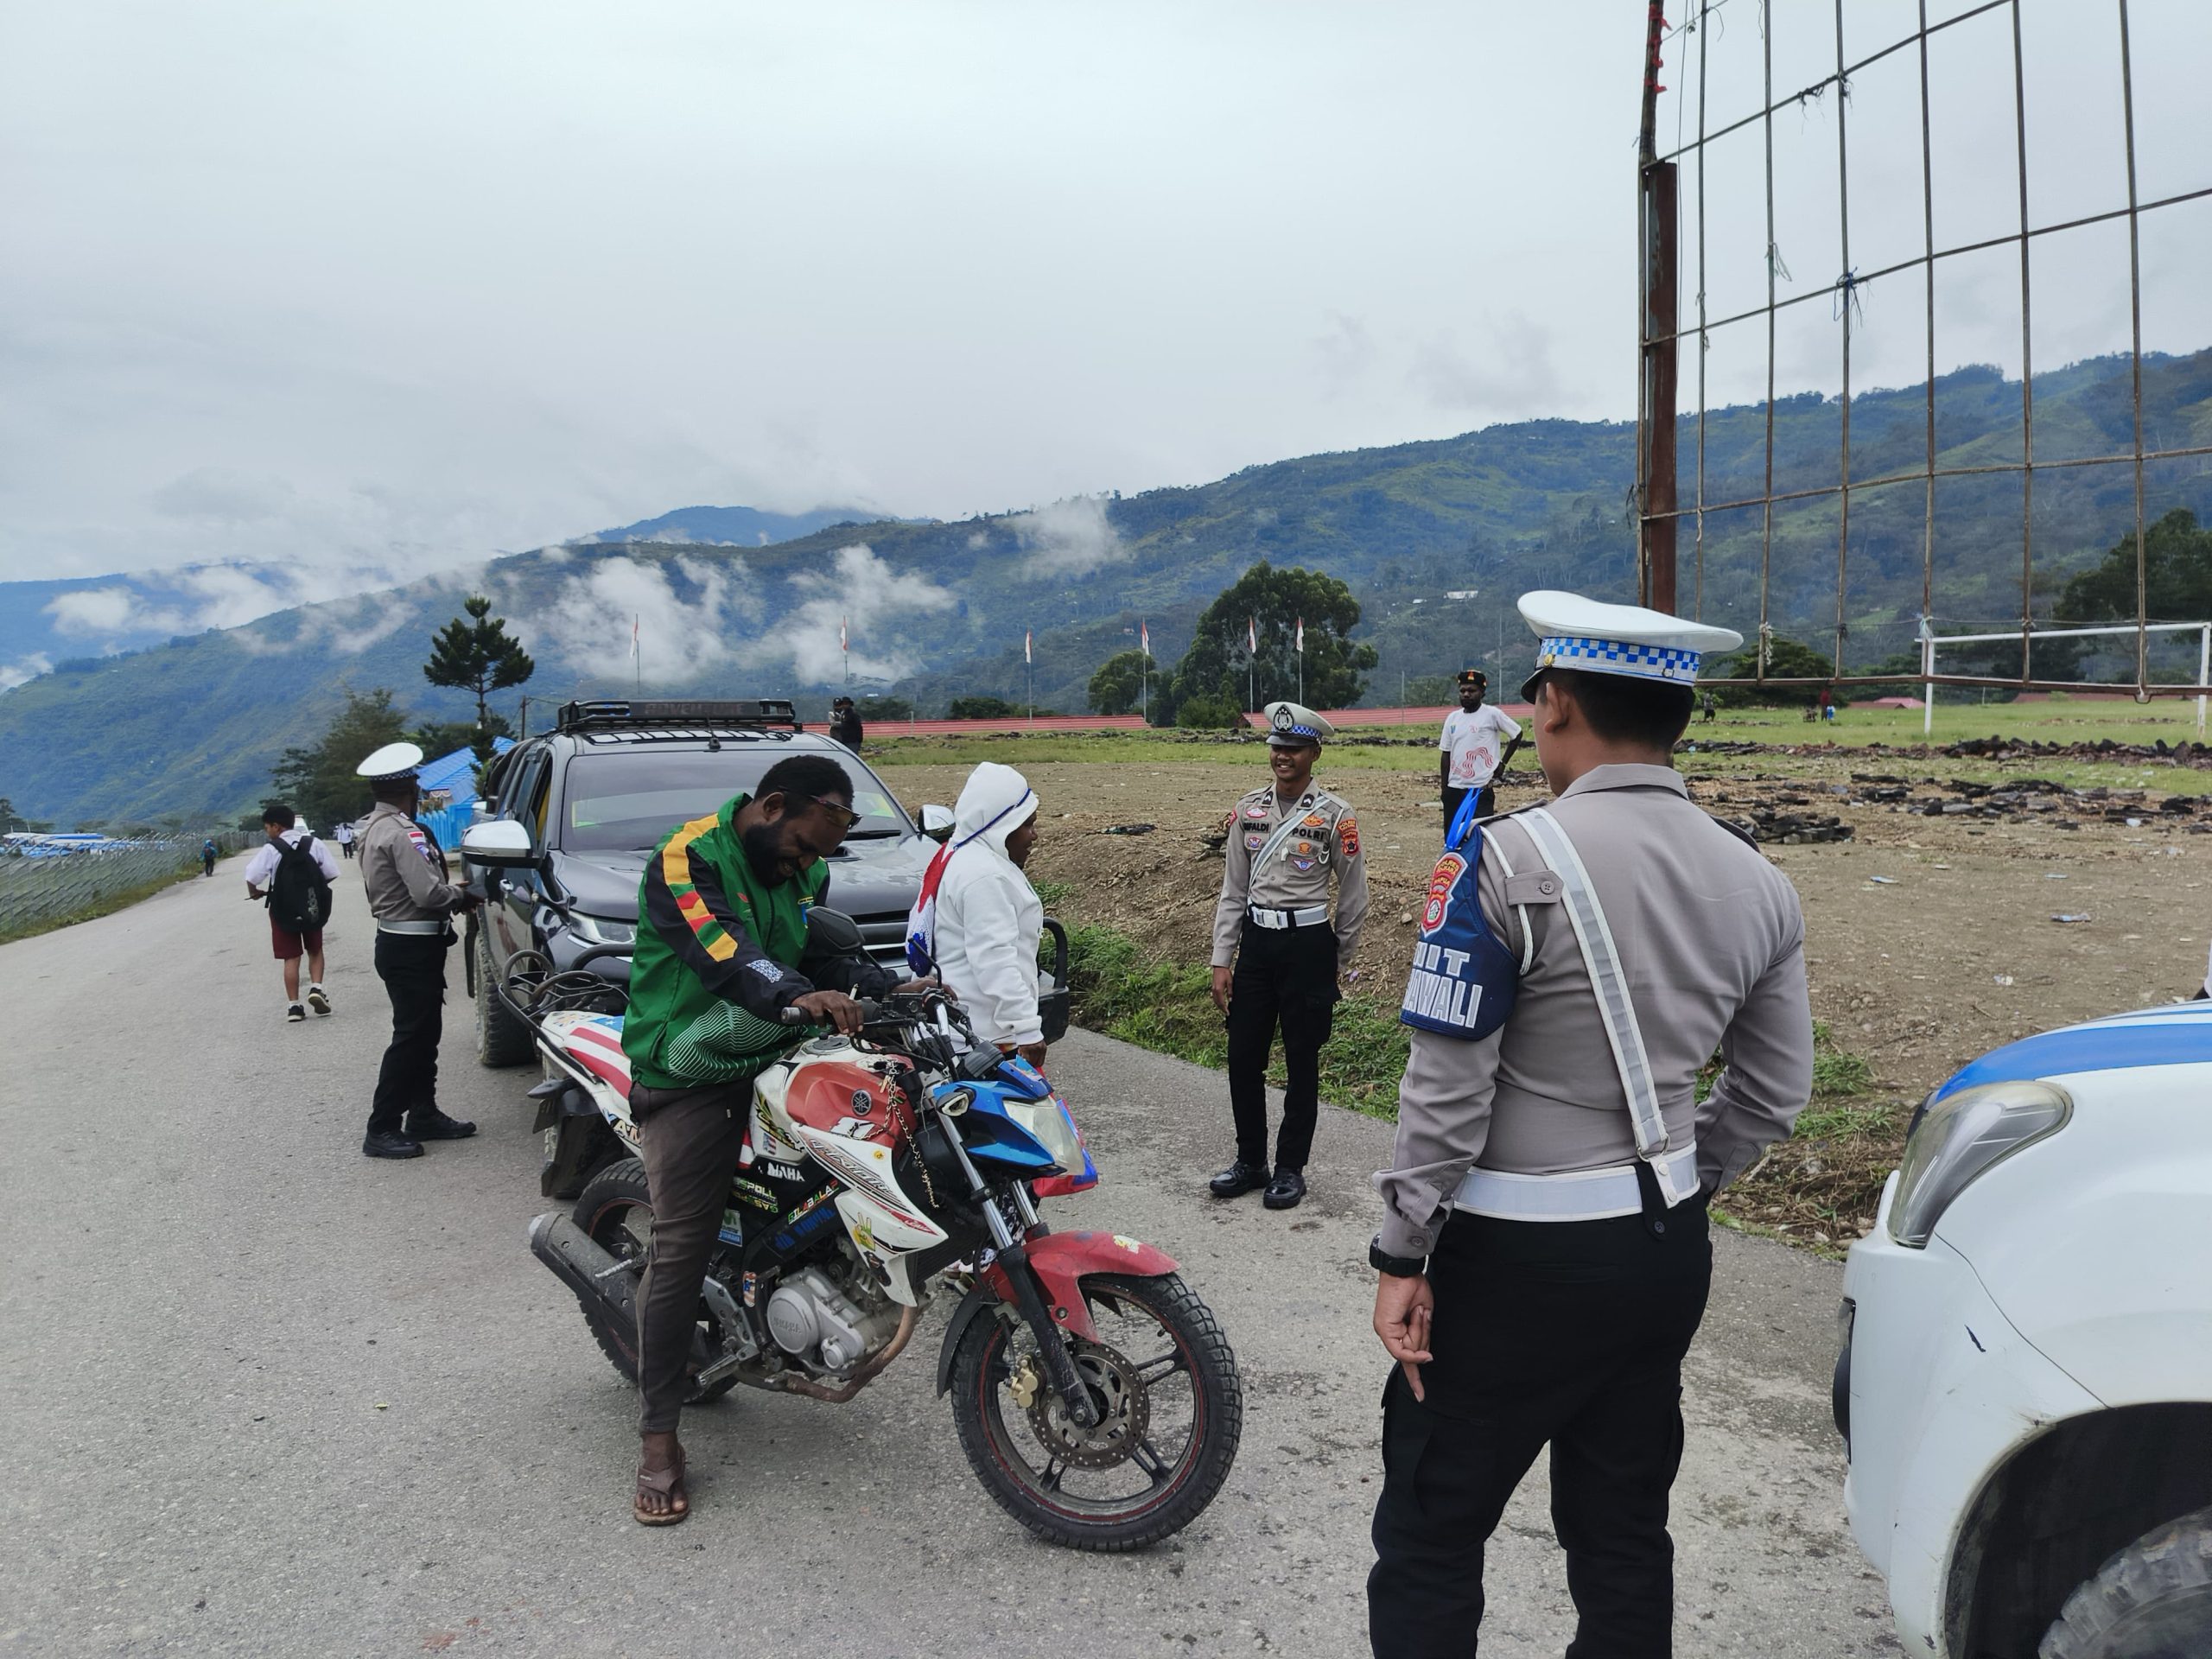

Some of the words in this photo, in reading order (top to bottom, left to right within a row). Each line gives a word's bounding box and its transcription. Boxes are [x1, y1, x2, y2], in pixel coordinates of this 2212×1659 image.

[1292, 828, 1325, 841] POLRI
[1413, 941, 1471, 977] NIT
[1402, 968, 1483, 1029] AWALI
